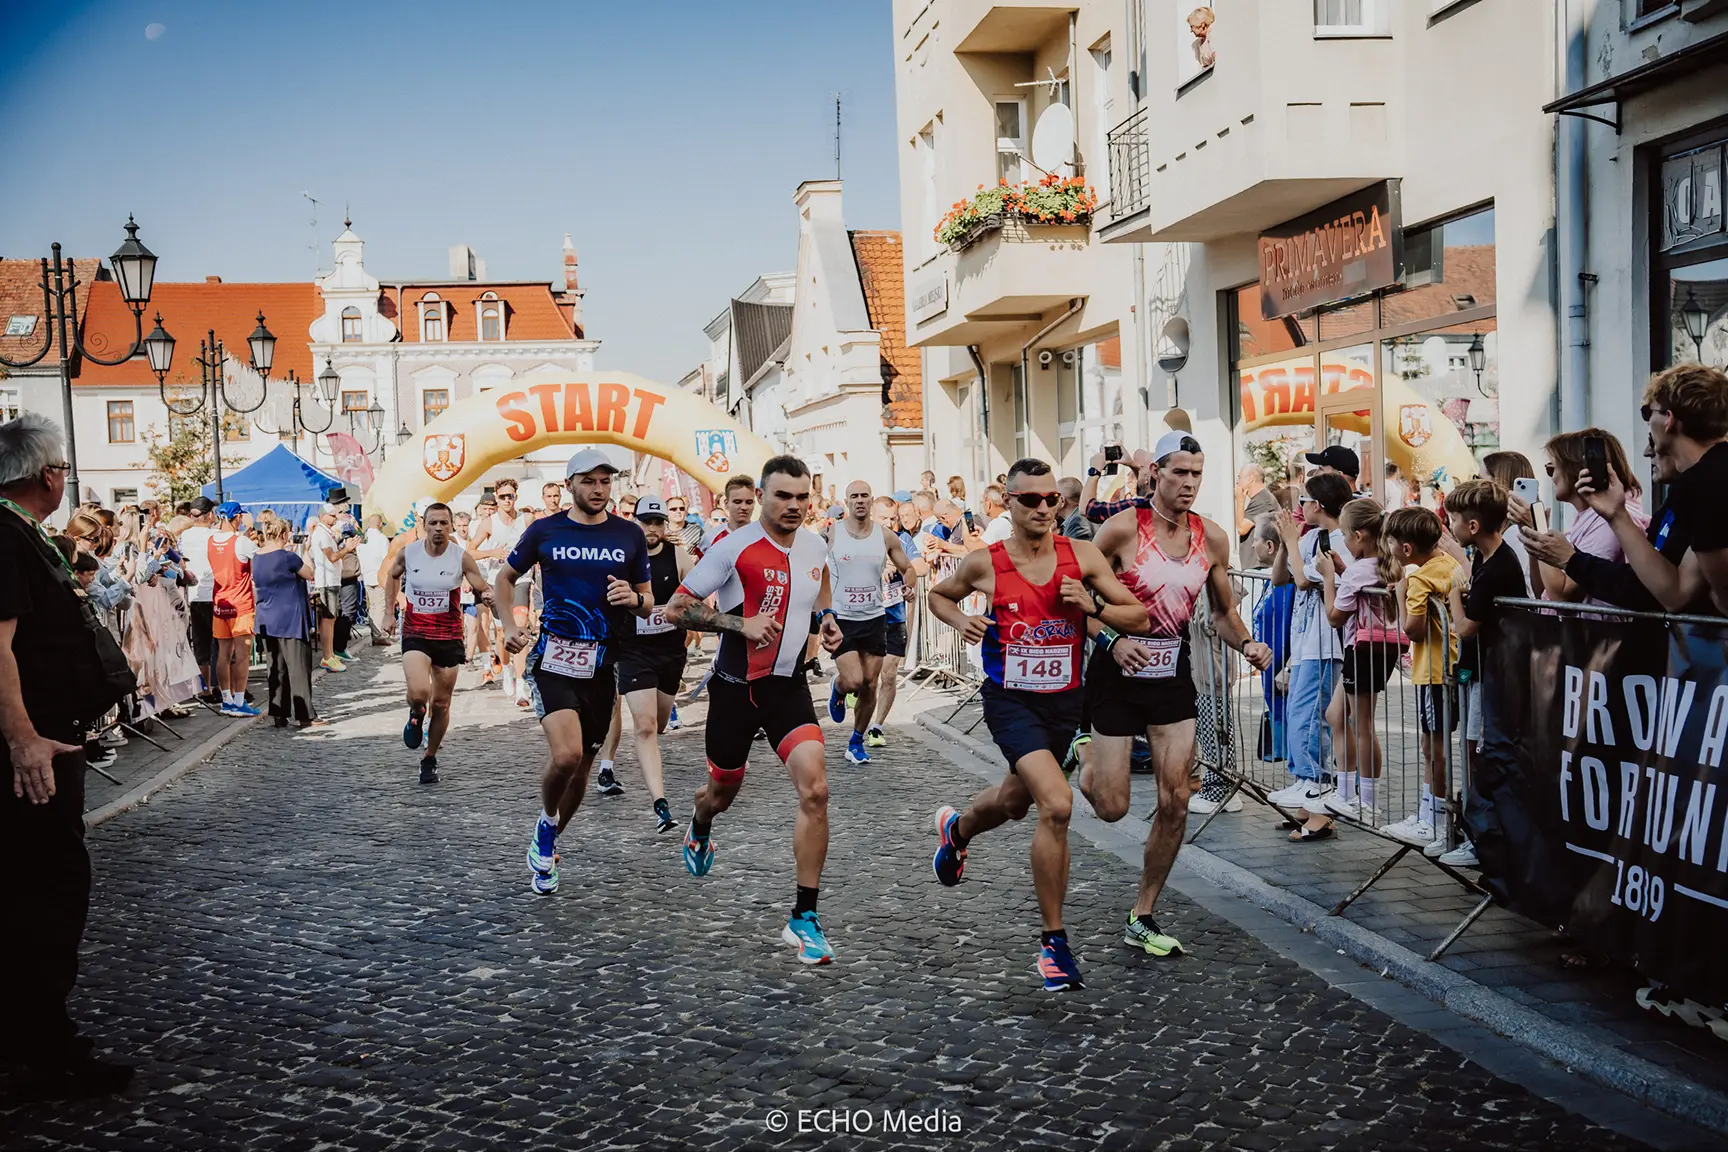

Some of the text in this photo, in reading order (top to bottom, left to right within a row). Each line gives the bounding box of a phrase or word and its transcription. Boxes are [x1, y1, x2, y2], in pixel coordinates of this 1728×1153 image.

[1262, 204, 1387, 286] PRIMAVERA
[496, 383, 666, 442] START
[552, 546, 626, 562] HOMAG
[418, 598, 445, 608] 037
[849, 592, 872, 603] 231
[551, 646, 589, 666] 225
[1017, 659, 1063, 678] 148
